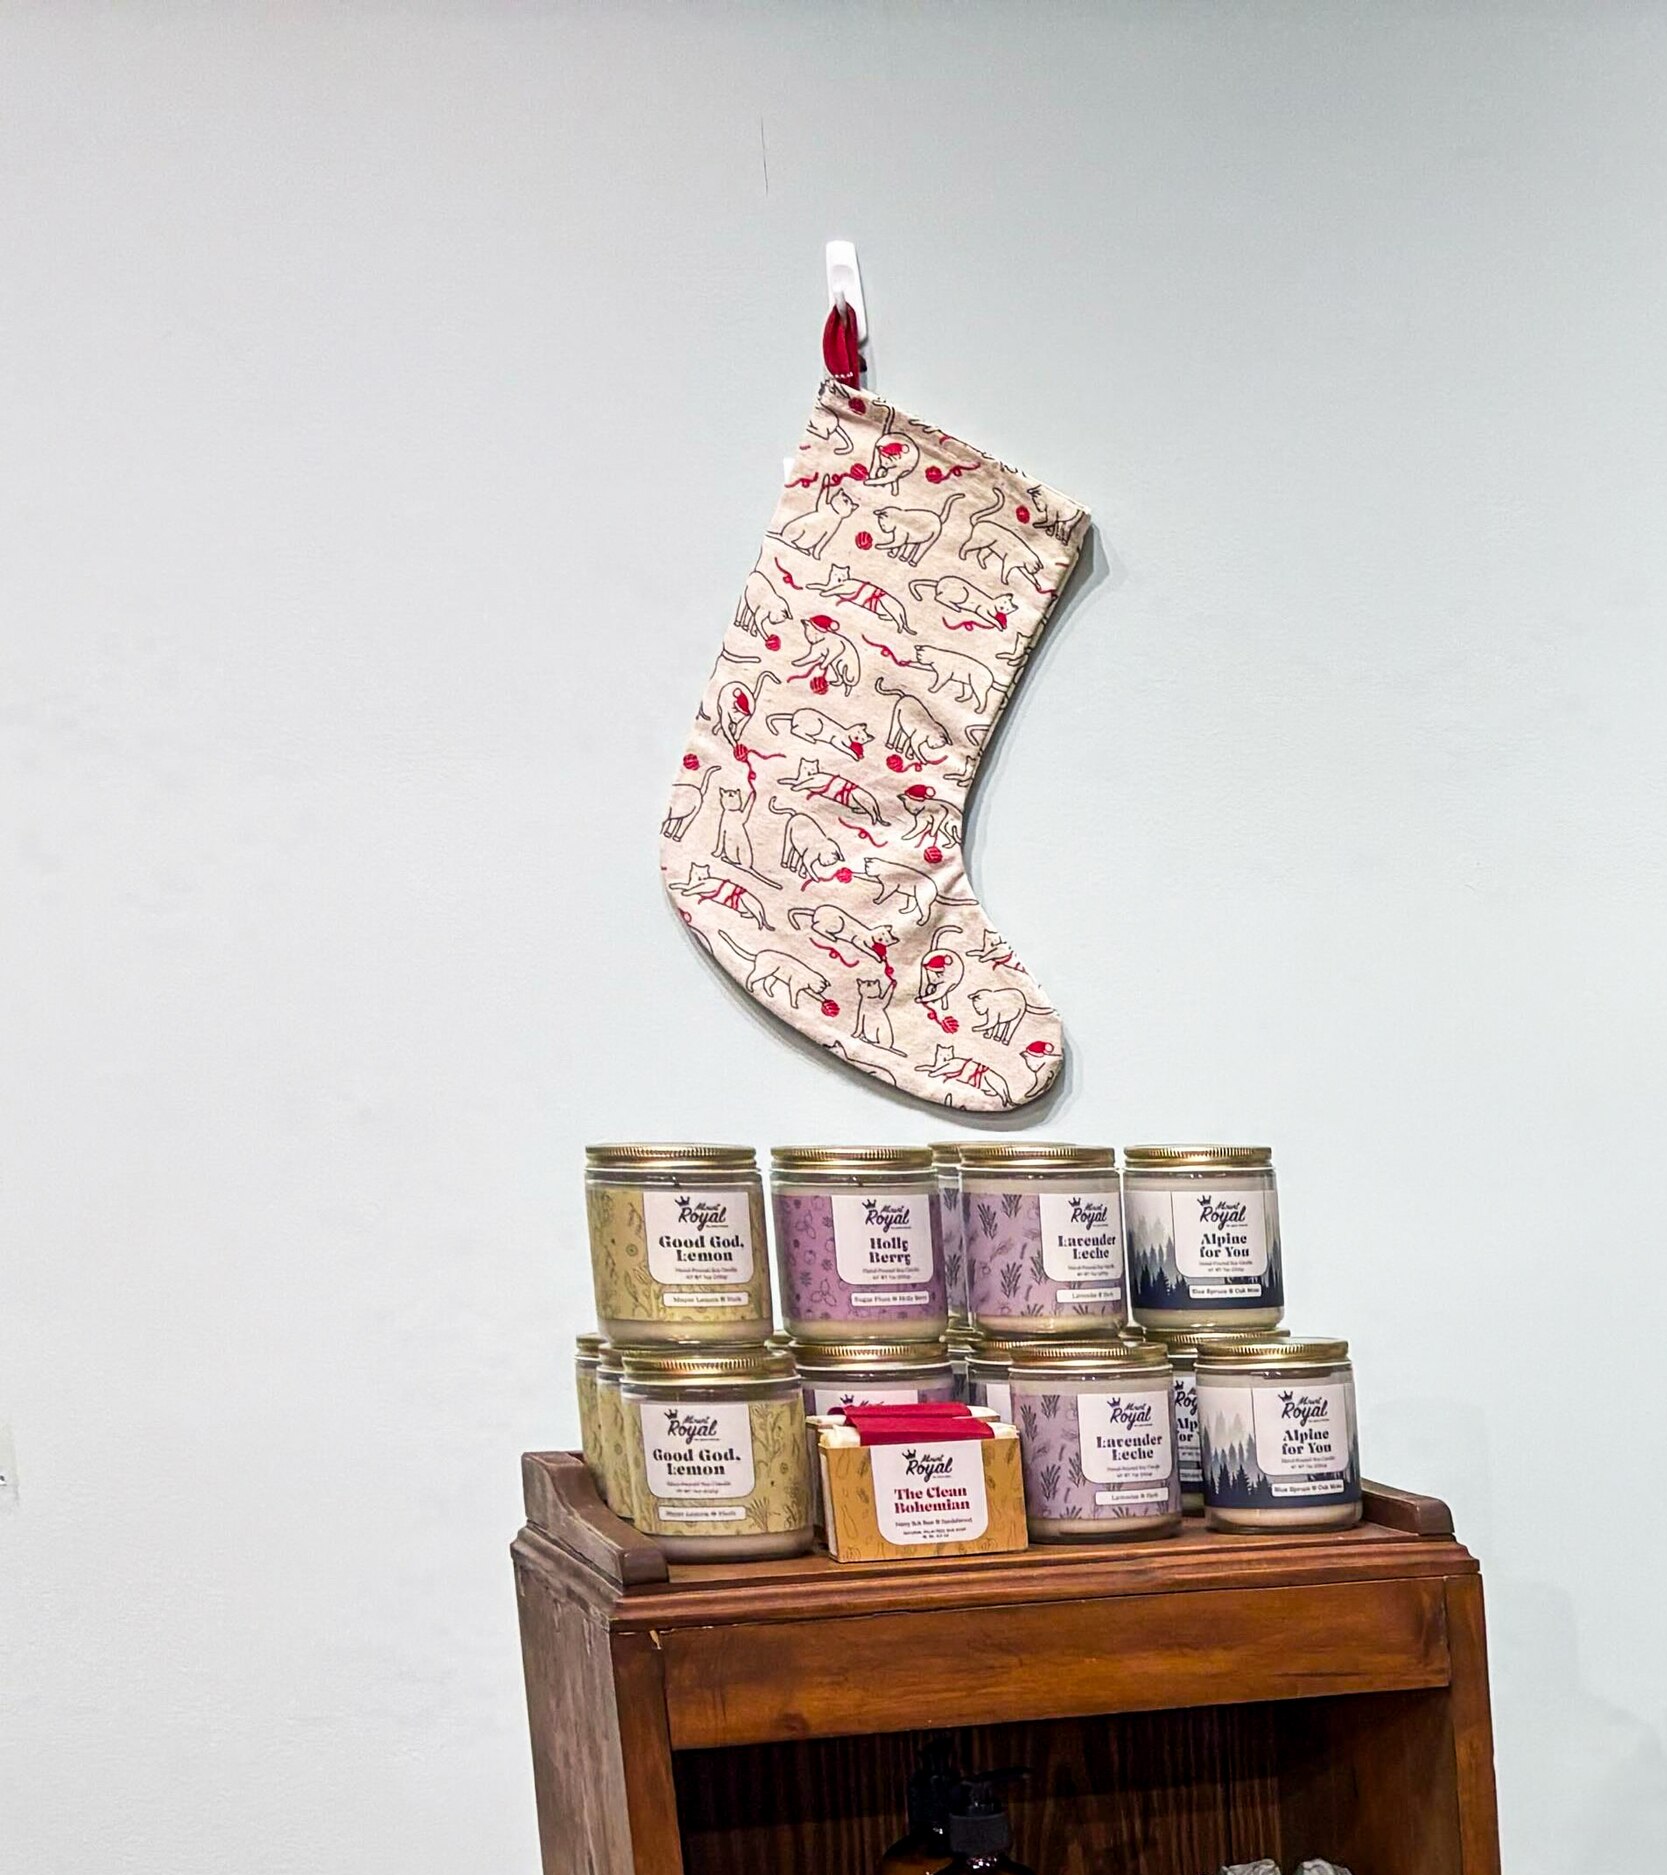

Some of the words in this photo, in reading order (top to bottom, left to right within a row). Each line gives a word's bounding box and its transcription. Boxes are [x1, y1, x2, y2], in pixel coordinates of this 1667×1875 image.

[679, 1206, 727, 1231] Royal
[865, 1207, 910, 1232] Royal
[1071, 1207, 1107, 1230] Royal
[1200, 1207, 1246, 1230] Royal
[870, 1237, 909, 1251] Holly
[1058, 1234, 1116, 1246] Lavender
[1201, 1233, 1247, 1245] Alpine
[677, 1250, 733, 1262] Lemon
[869, 1252, 911, 1265] Berry
[1073, 1247, 1109, 1260] Leche
[1200, 1246, 1222, 1258] for
[1225, 1247, 1249, 1257] You
[1110, 1406, 1152, 1430] Royal
[1281, 1401, 1328, 1427] Royal
[668, 1419, 717, 1444] Royal
[1283, 1429, 1329, 1442] Alpine
[1096, 1435, 1162, 1449] Lavender
[1282, 1443, 1306, 1455] for
[1308, 1442, 1332, 1454] You
[1112, 1448, 1154, 1461] Leche
[666, 1464, 725, 1476] Lemon
[906, 1456, 953, 1482] Royal
[894, 1488, 924, 1500] The
[929, 1486, 967, 1498] Clean
[894, 1499, 970, 1514] Bohemian
